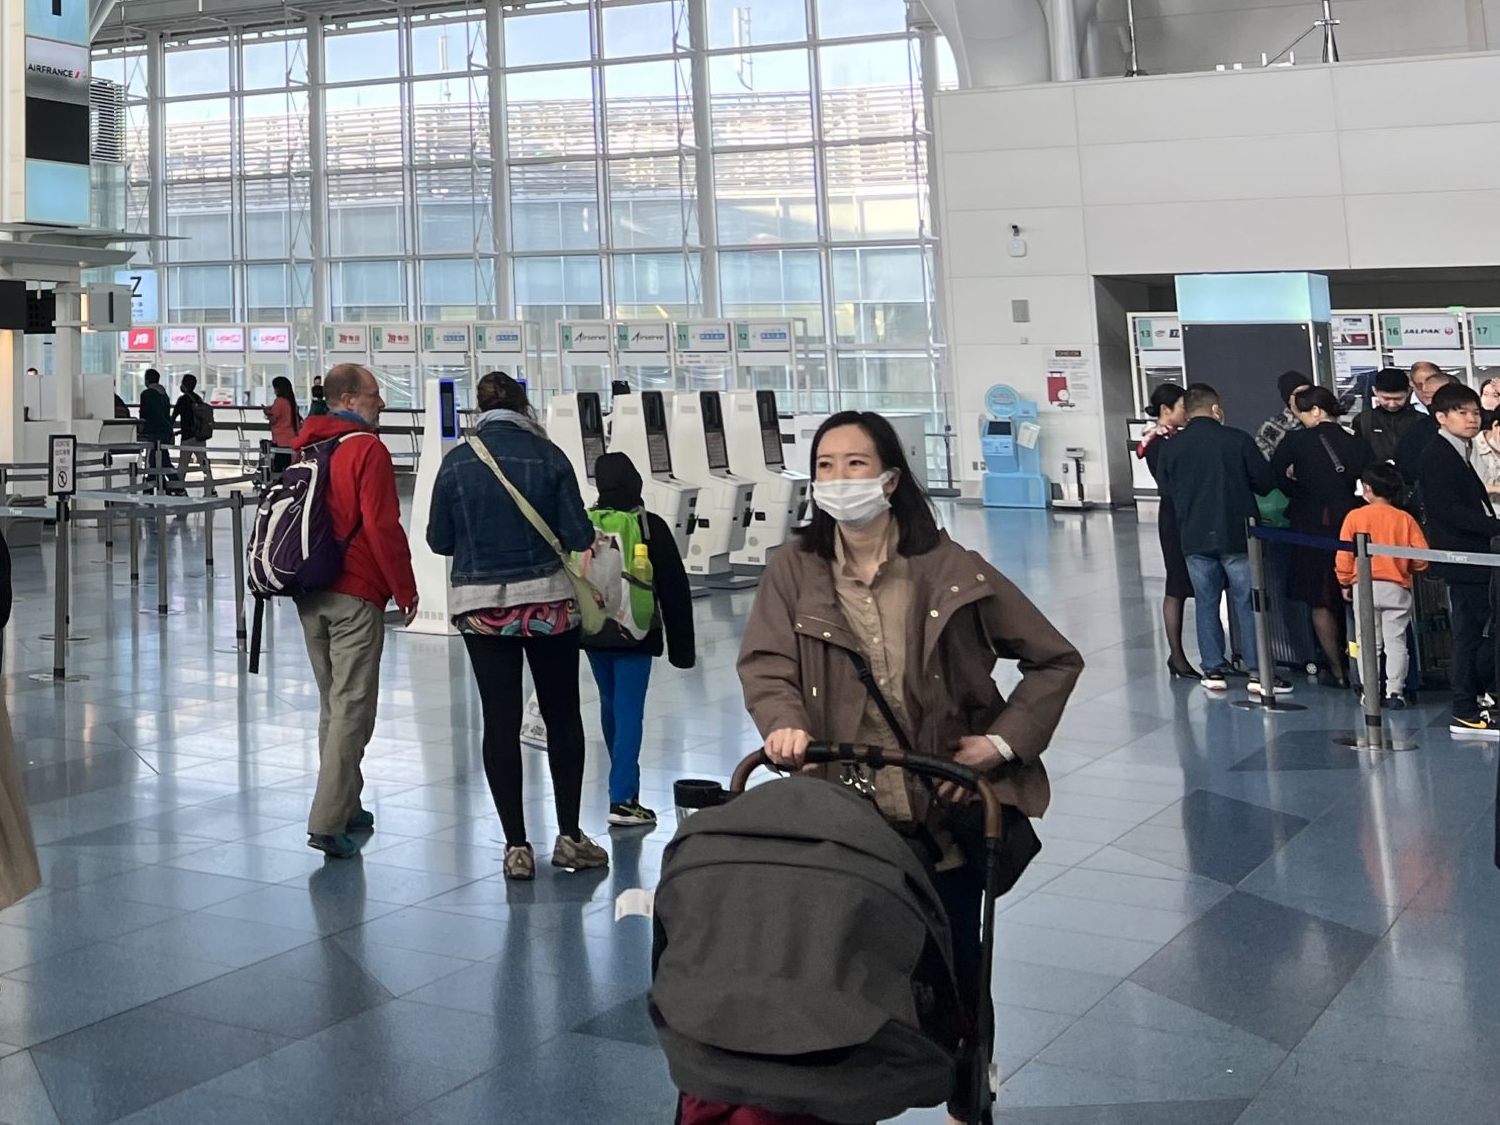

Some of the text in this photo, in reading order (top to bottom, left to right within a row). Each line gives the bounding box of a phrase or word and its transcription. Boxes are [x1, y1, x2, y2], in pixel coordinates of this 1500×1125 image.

[27, 63, 74, 78] AIRFRANCE
[130, 276, 143, 297] Z
[1387, 327, 1399, 336] 16
[1476, 327, 1488, 335] 17
